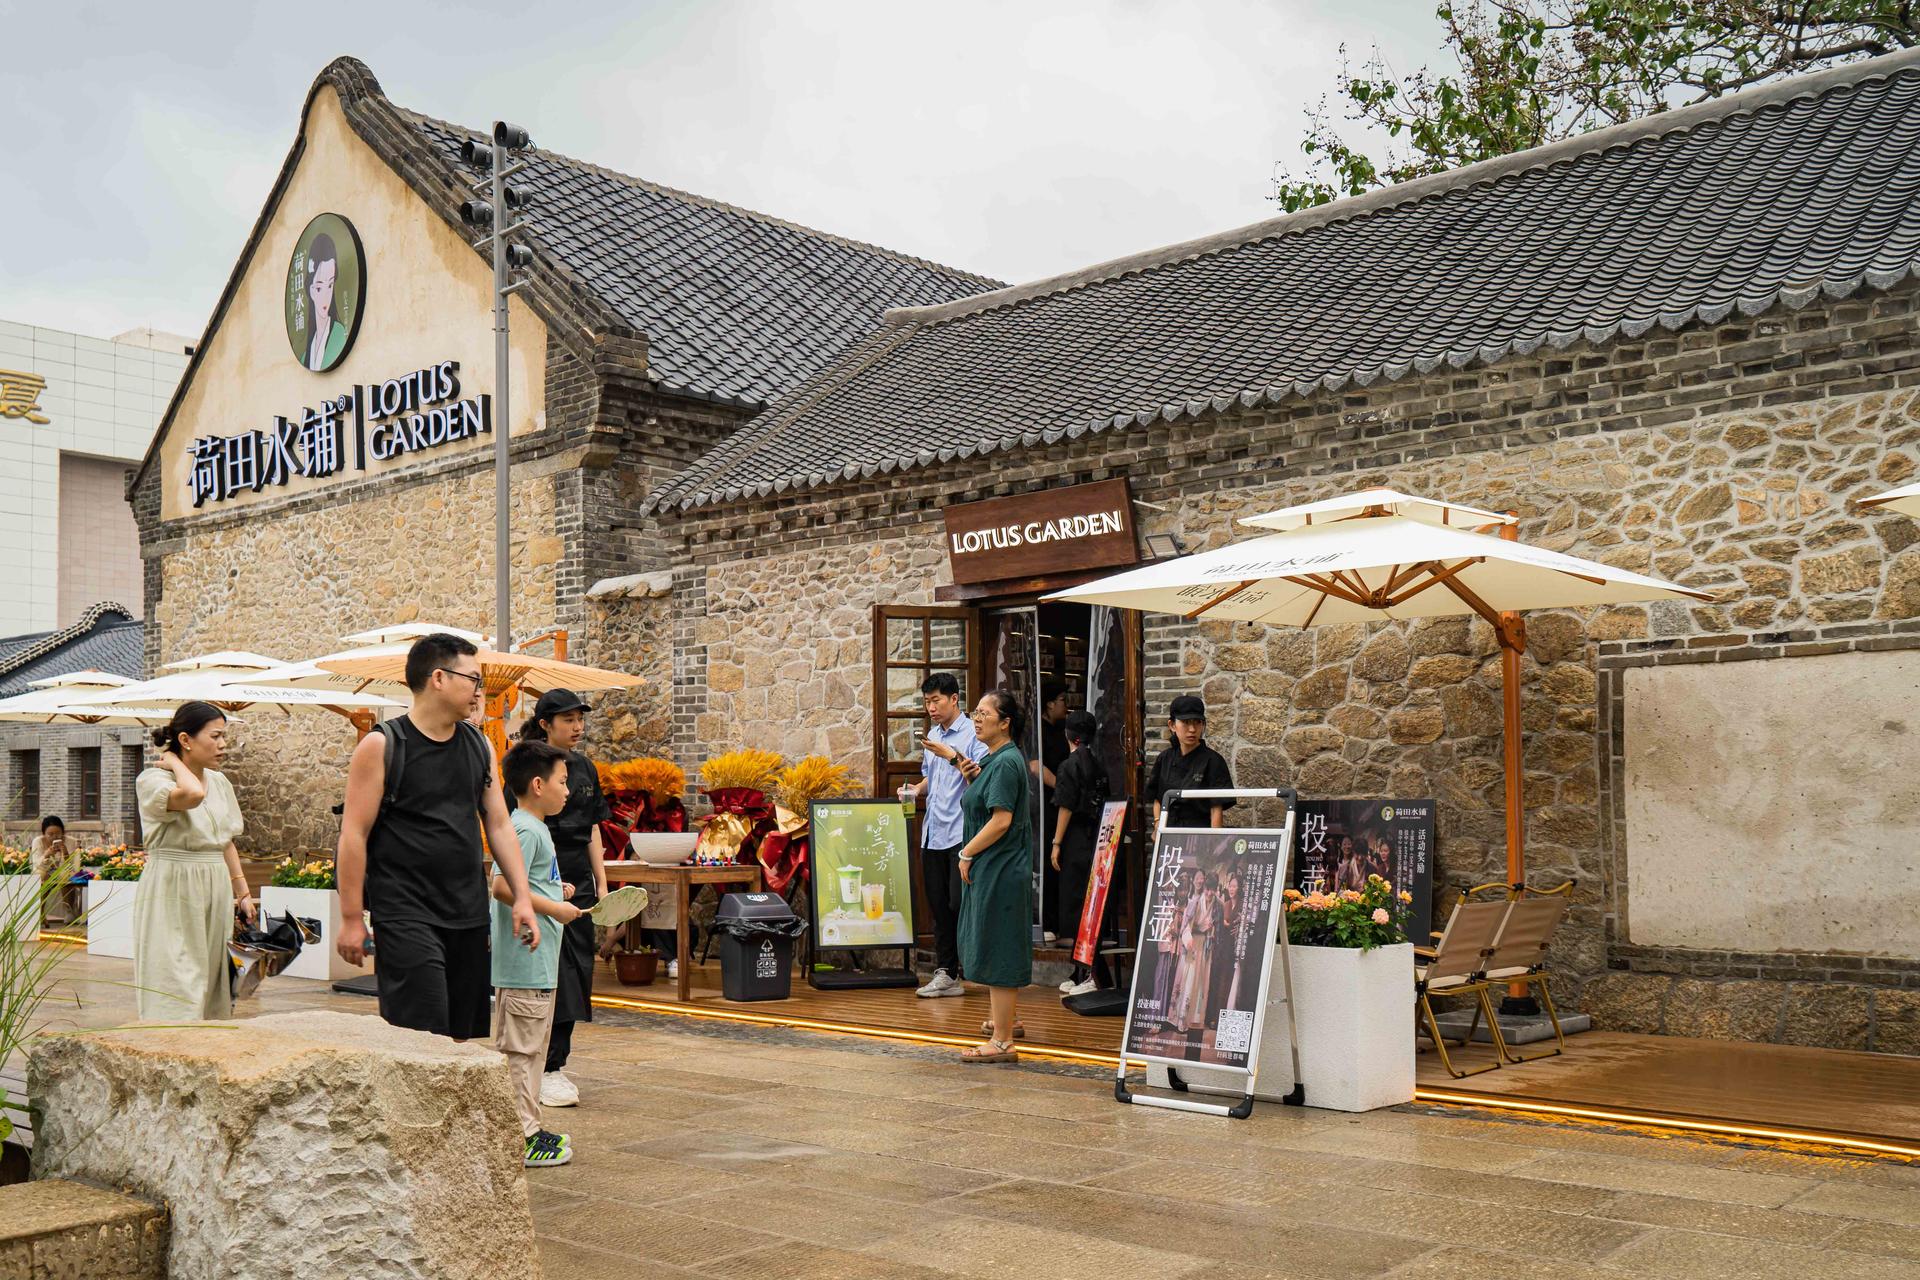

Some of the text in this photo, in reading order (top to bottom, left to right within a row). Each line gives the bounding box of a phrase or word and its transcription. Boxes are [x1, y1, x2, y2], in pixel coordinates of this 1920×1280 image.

[367, 361, 459, 421] LOTUS
[187, 401, 345, 507] 荷田水铺
[369, 394, 491, 460] GARDEN
[952, 510, 1123, 554] LOTUS GARDEN
[1417, 829, 1426, 874] 活动奖励
[1260, 863, 1274, 911] 活动奖励
